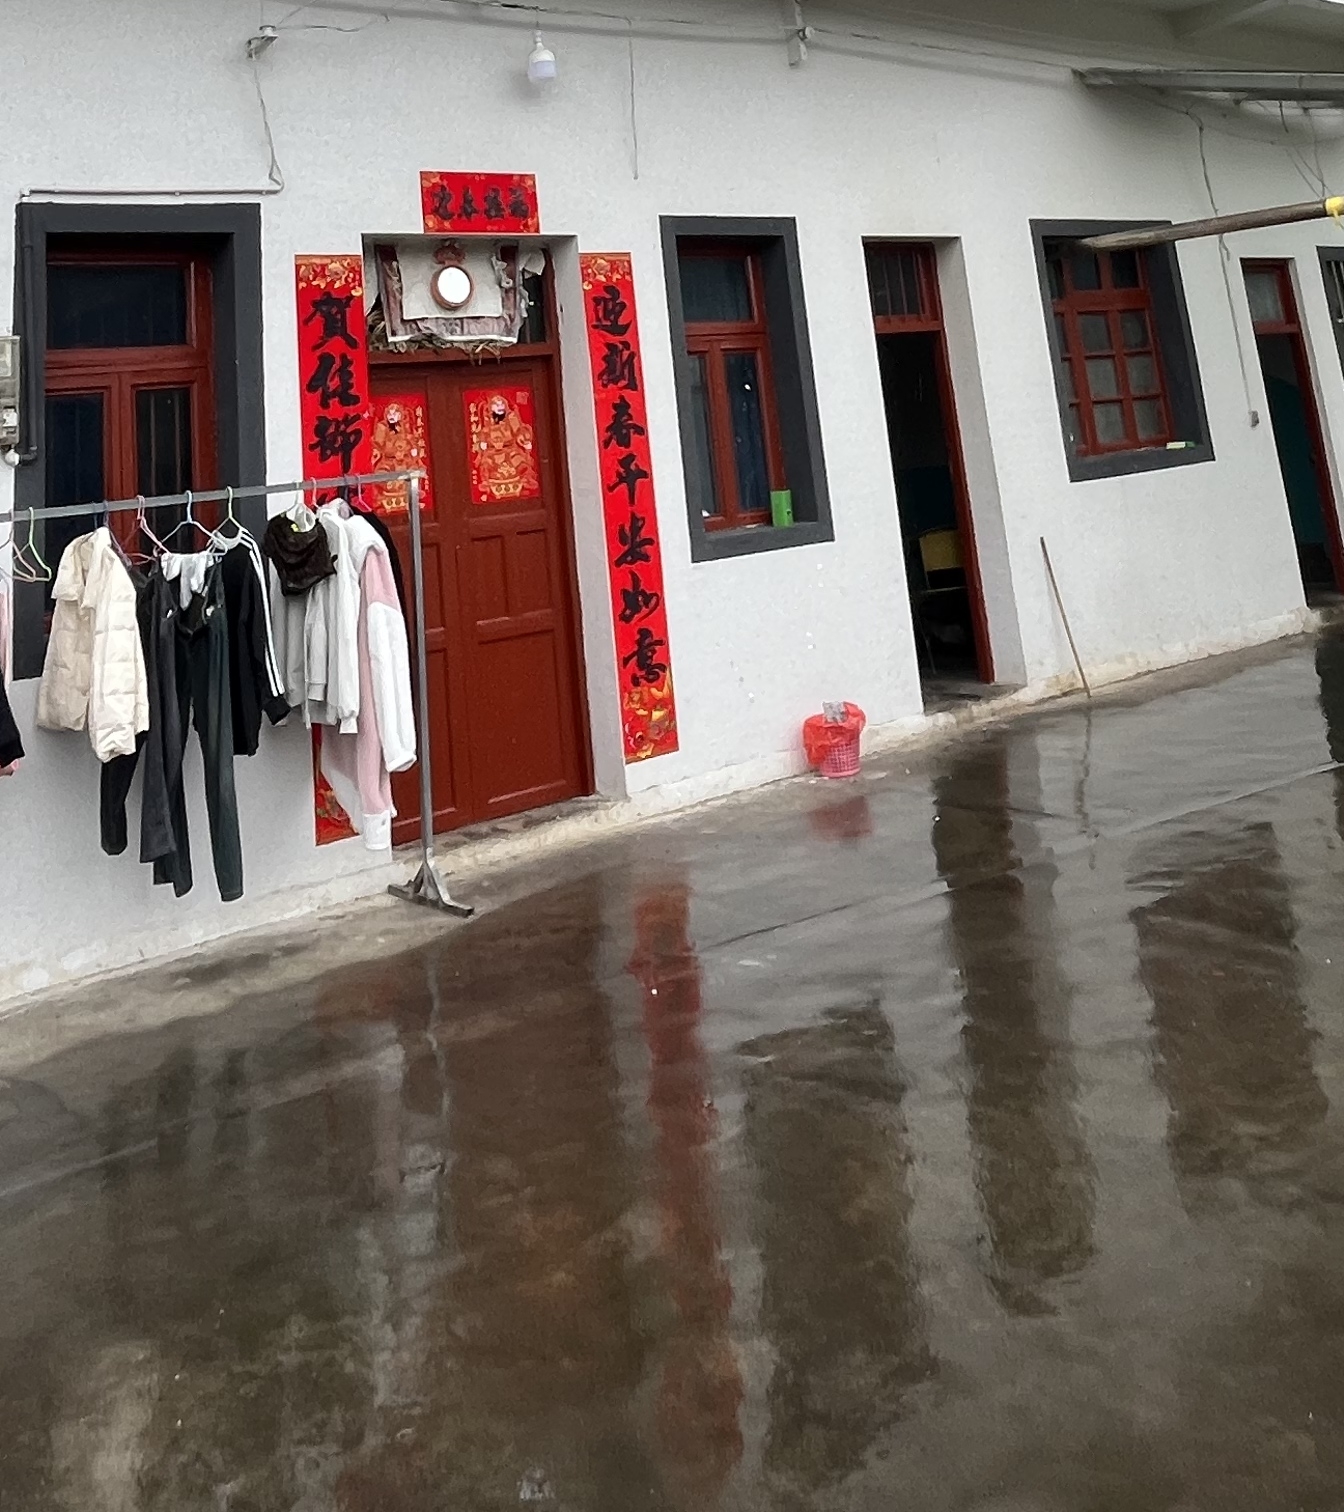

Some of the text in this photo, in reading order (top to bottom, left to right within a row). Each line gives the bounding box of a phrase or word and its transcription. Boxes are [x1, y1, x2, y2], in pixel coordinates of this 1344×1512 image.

[591, 285, 666, 687] 迎新春平安如意
